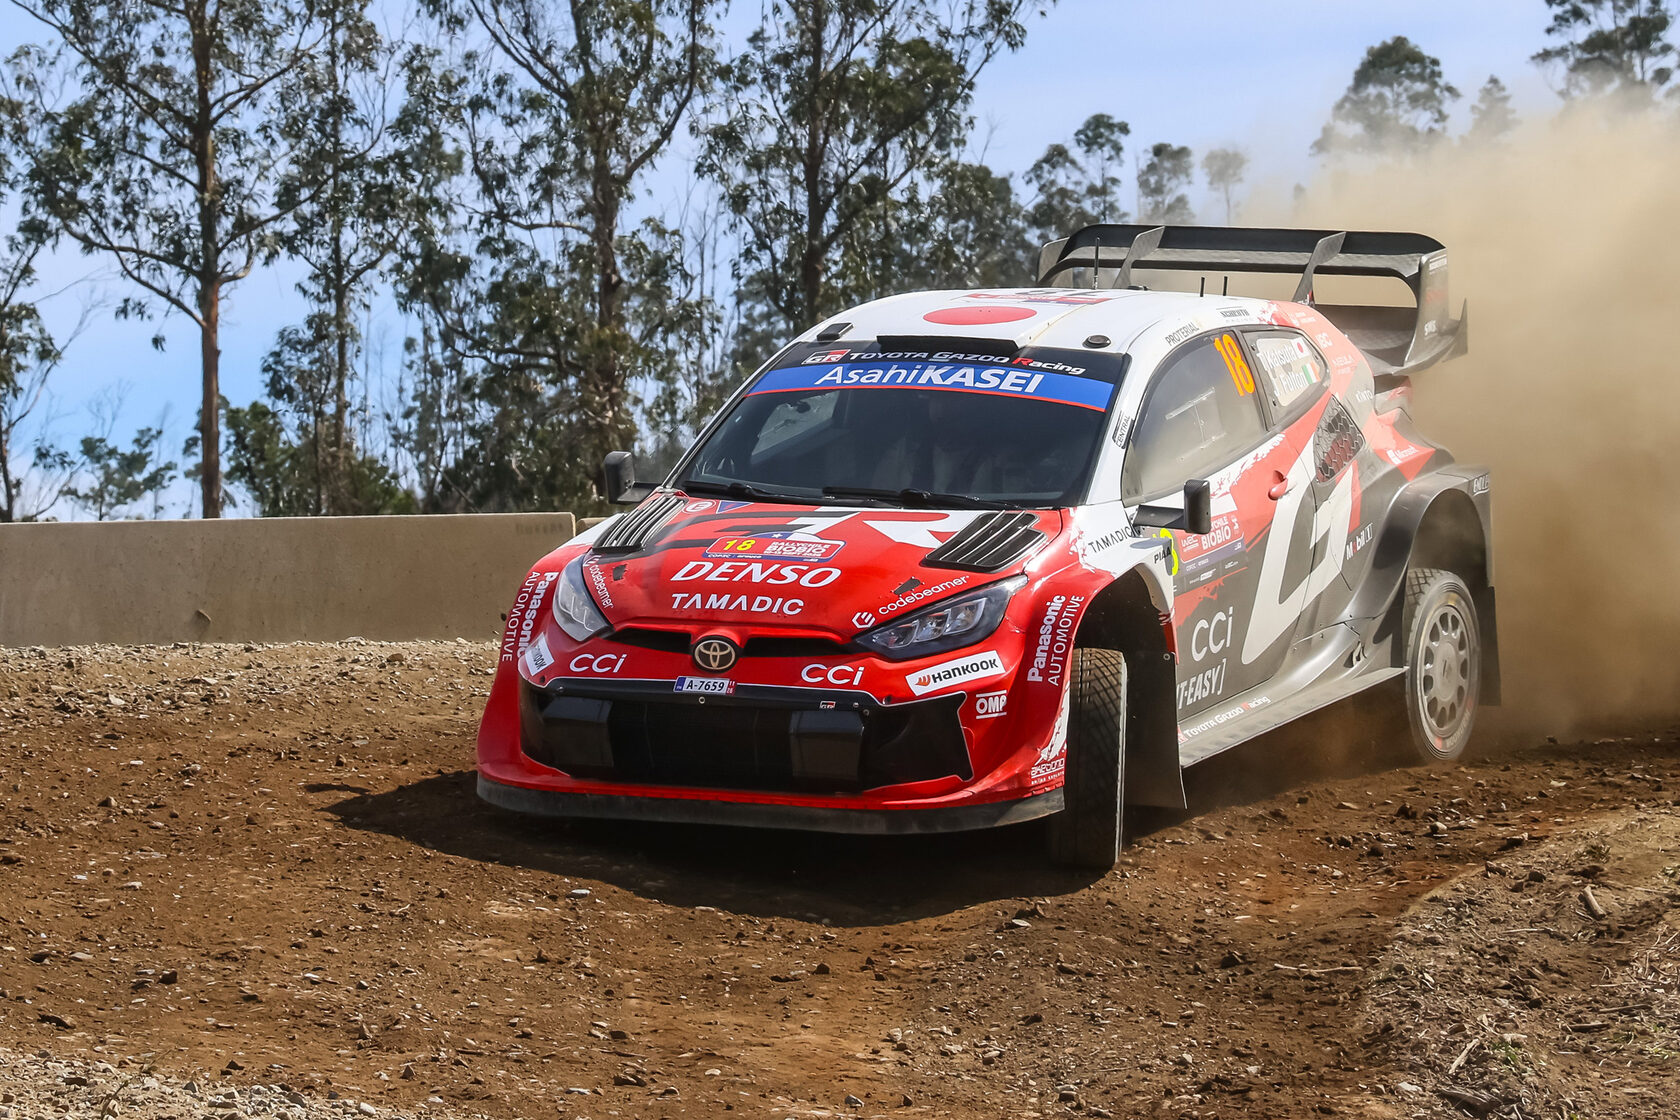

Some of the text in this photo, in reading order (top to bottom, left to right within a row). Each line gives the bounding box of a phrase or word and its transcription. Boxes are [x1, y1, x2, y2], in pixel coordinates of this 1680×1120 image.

[1165, 321, 1200, 346] PROTERIAL
[850, 352, 929, 361] TOYOTA
[927, 351, 1010, 363] GAZOO
[1011, 357, 1086, 375] Racing
[1214, 334, 1255, 396] 18
[815, 364, 1045, 393] AsahiKASEI
[1115, 414, 1132, 448] CENTRAL
[723, 539, 756, 551] 18
[766, 544, 826, 555] BIOBIO
[1088, 526, 1132, 553] TAMADIC
[1201, 526, 1231, 550] BIOBIO
[1154, 547, 1171, 564] PIAA
[589, 563, 613, 608] codebeamer
[670, 561, 842, 588] DENSO
[671, 593, 804, 616] TAMADIC
[878, 576, 968, 615] codebeamer
[502, 571, 540, 661] AUTOMOTIVE
[517, 571, 559, 659] Panasonic
[1027, 594, 1066, 682] Panasonic
[1047, 595, 1084, 686] AUTOMOTIVE
[686, 680, 725, 691] A-7659
[976, 694, 1007, 714] OMP
[1183, 720, 1217, 738] TOYOTA
[1214, 706, 1244, 724] GAZOO
[1240, 696, 1271, 711] Racing
